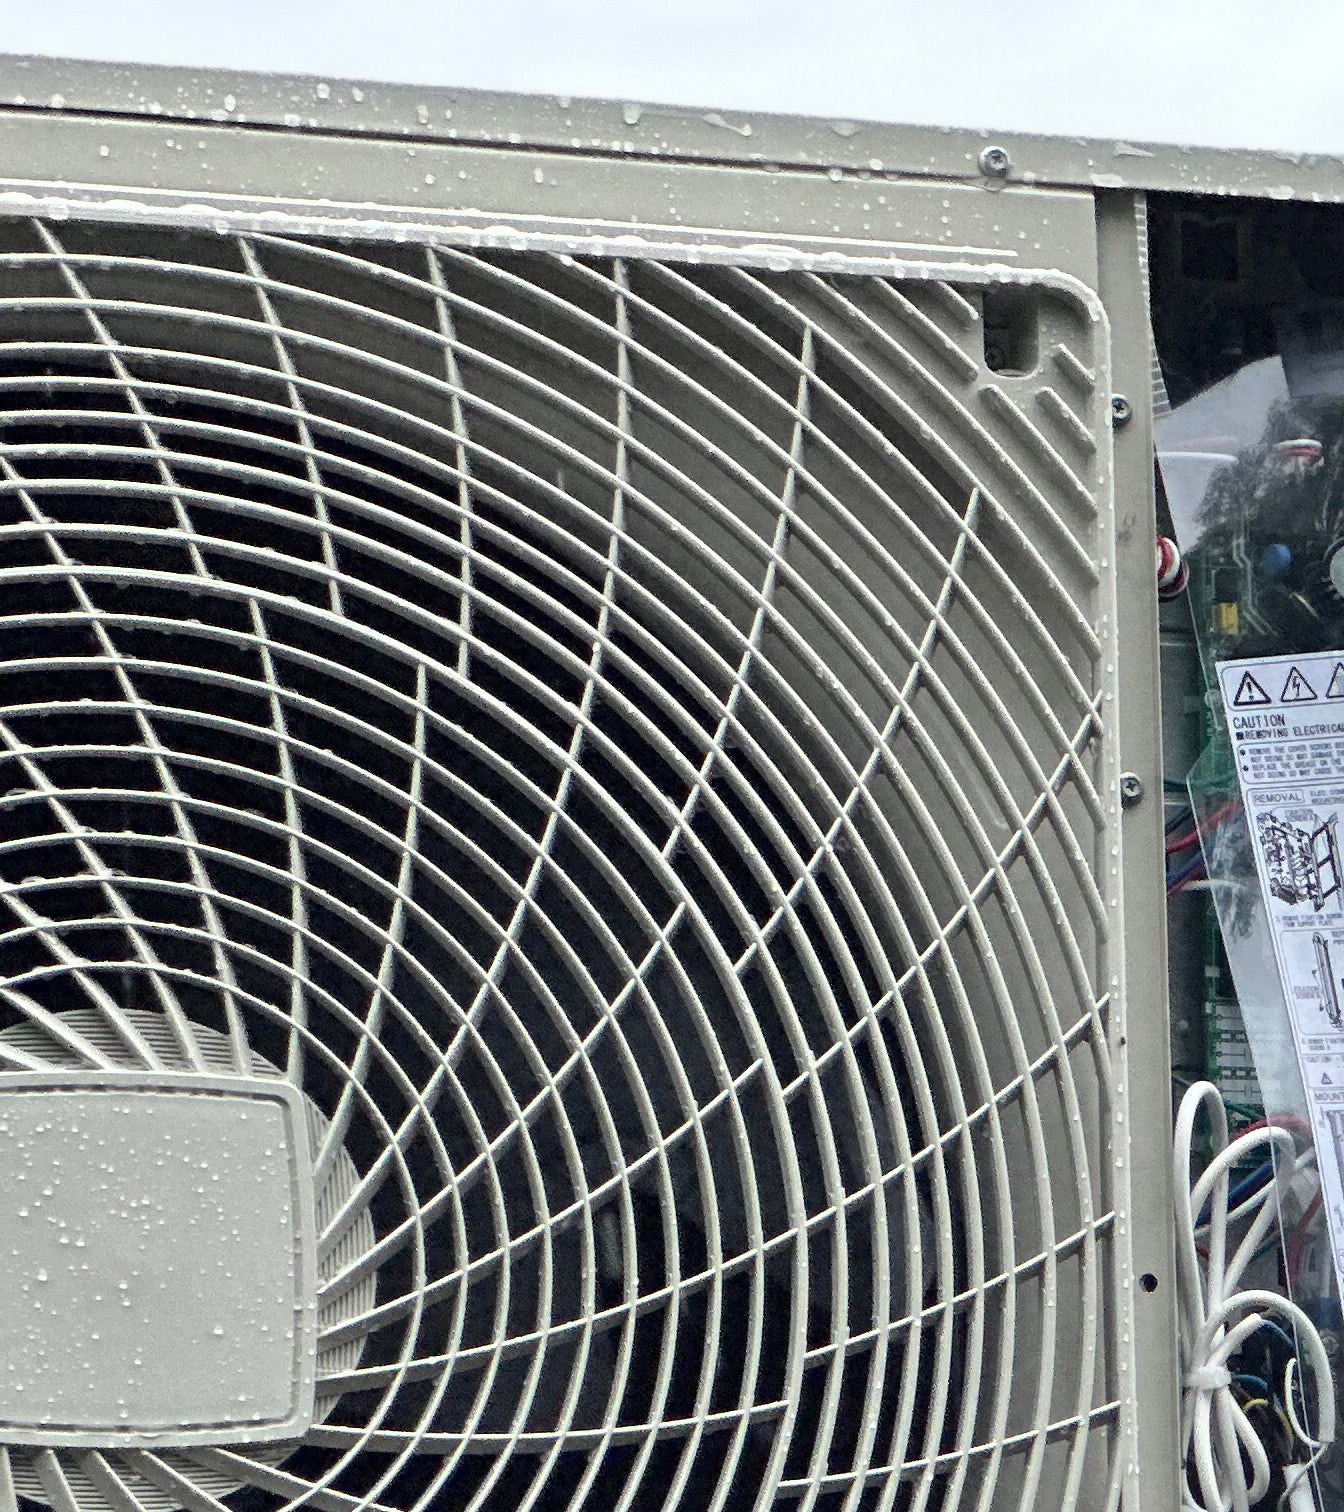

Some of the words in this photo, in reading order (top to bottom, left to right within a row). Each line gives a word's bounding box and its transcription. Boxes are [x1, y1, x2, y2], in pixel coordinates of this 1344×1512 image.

[1231, 712, 1286, 730] CAUTION
[1242, 726, 1289, 741] REMOVING
[1253, 790, 1302, 805] REMOVAL
